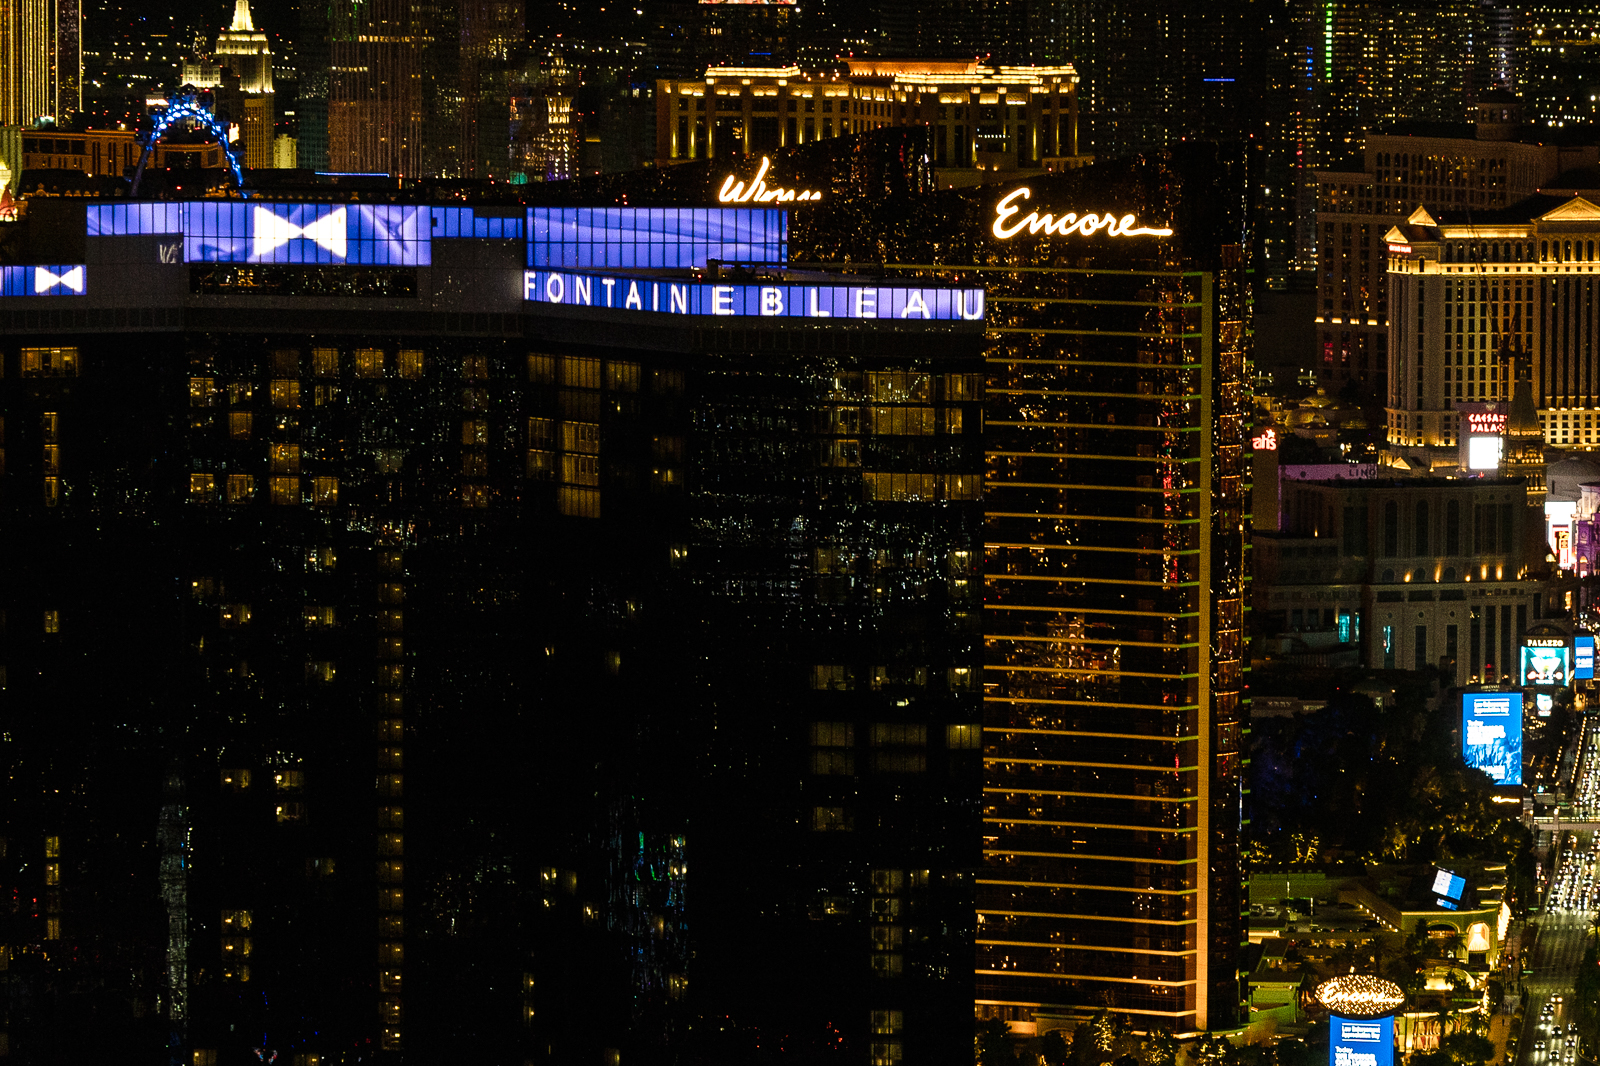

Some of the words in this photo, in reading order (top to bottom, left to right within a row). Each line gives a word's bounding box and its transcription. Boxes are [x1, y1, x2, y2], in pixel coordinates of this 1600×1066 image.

[993, 187, 1173, 239] Encore
[523, 271, 985, 321] FONTAINEBLEAU
[1470, 423, 1505, 433] PALA
[1527, 639, 1564, 647] PALAZZO
[1321, 981, 1405, 1003] Encore
